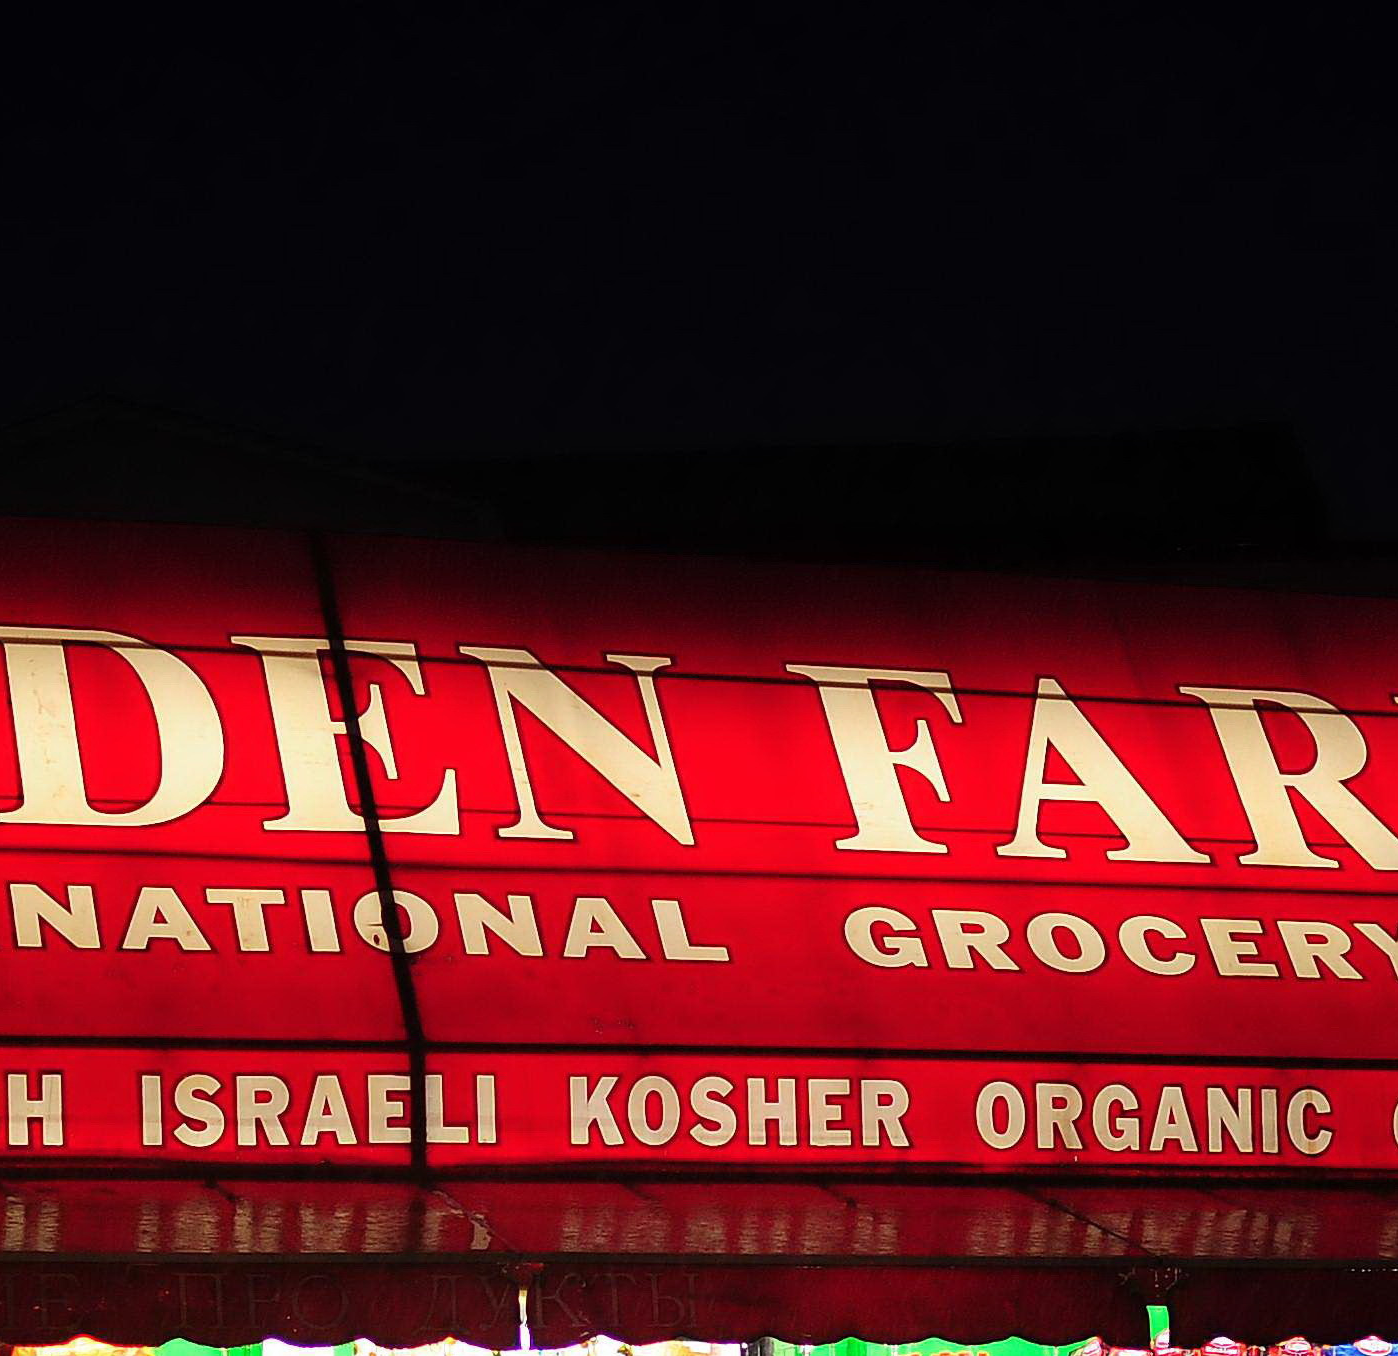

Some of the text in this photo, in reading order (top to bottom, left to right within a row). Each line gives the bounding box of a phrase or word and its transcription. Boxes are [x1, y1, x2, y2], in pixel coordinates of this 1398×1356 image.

[141, 1073, 497, 1148] ISRAELI
[569, 1075, 910, 1149] KOSHER
[975, 1081, 1333, 1156] ORGANIC
